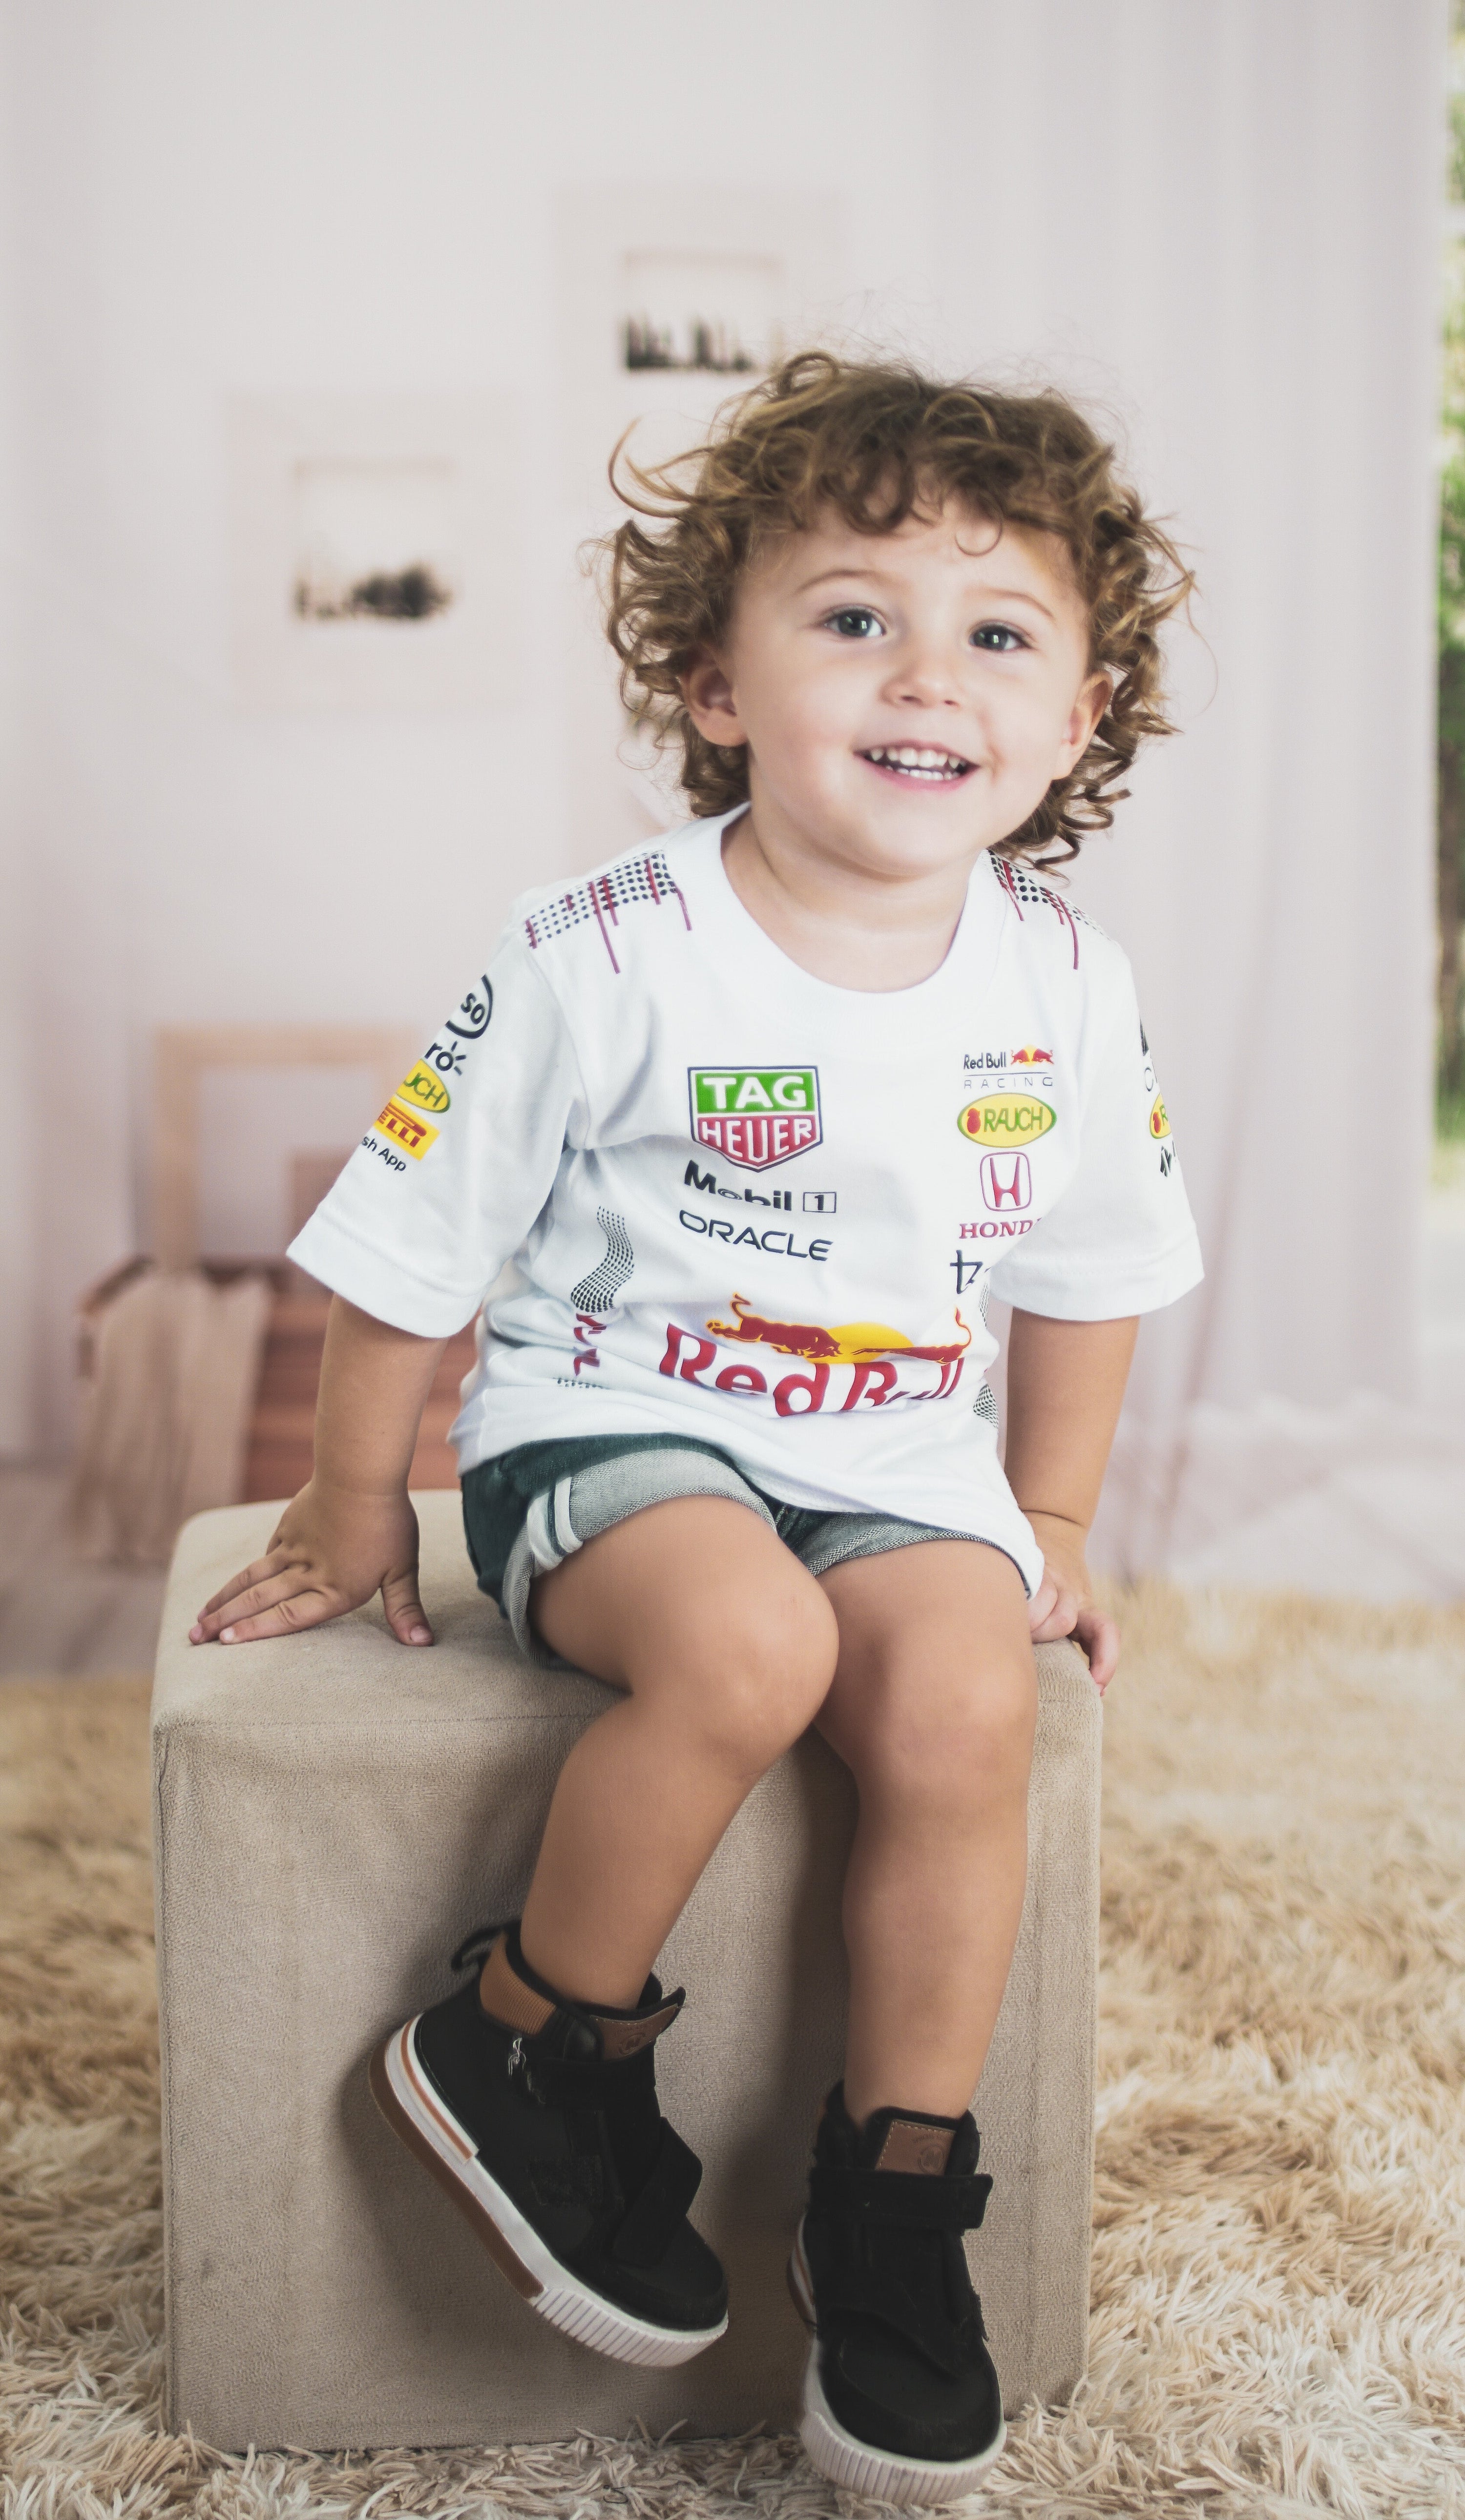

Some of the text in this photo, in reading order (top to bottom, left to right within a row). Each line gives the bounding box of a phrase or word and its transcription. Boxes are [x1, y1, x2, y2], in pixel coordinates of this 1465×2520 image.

[963, 1051, 1006, 1070] Red Bull
[703, 1076, 807, 1109] TAG
[964, 1077, 1053, 1089] RACING
[984, 1106, 1043, 1132] RAUCH
[701, 1118, 812, 1160] HEUER
[378, 1148, 406, 1171] App
[684, 1159, 792, 1211] Mobil
[679, 1210, 833, 1261] ORACLE
[959, 1217, 1042, 1239] HOND
[659, 1322, 830, 1417] Red
[839, 1357, 965, 1411] Bll
